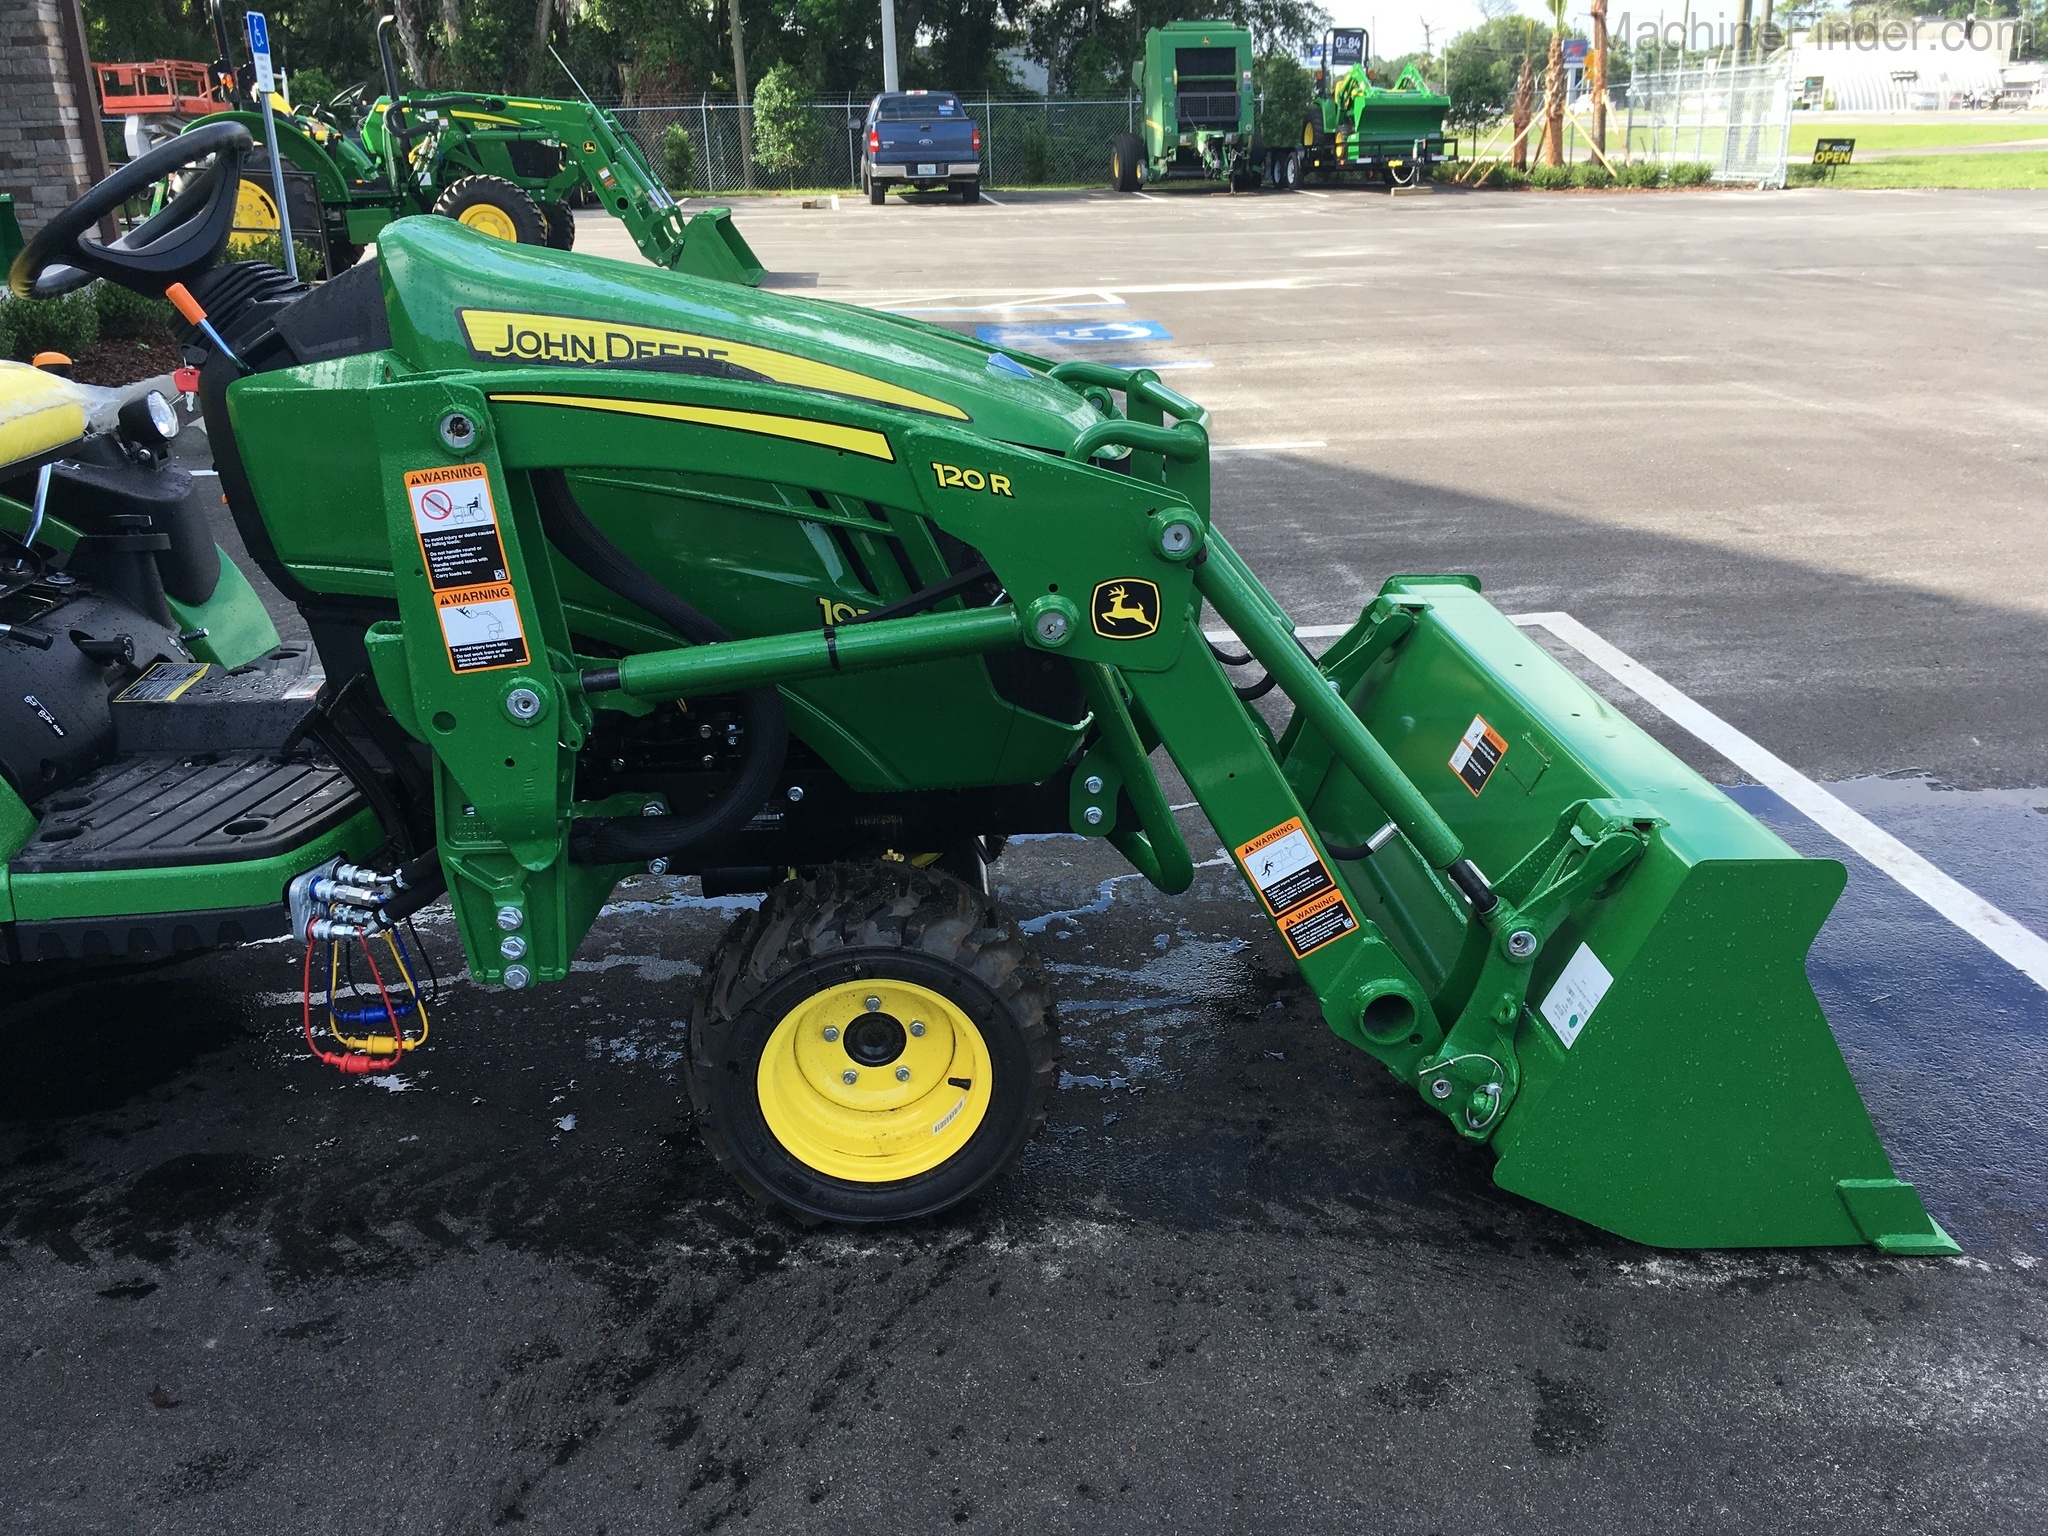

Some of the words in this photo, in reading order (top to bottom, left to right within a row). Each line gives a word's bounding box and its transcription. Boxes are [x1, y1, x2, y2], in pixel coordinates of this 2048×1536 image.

[1348, 37, 1360, 49] 84
[1815, 152, 1850, 163] OPEN
[495, 324, 595, 360] JOHN
[421, 466, 482, 483] WARNING
[932, 462, 986, 491] 120
[990, 473, 1013, 497] R
[450, 587, 510, 603] WARNING
[819, 597, 870, 626] 10
[1254, 823, 1294, 848] WARNING
[1296, 896, 1336, 920] WARNING
